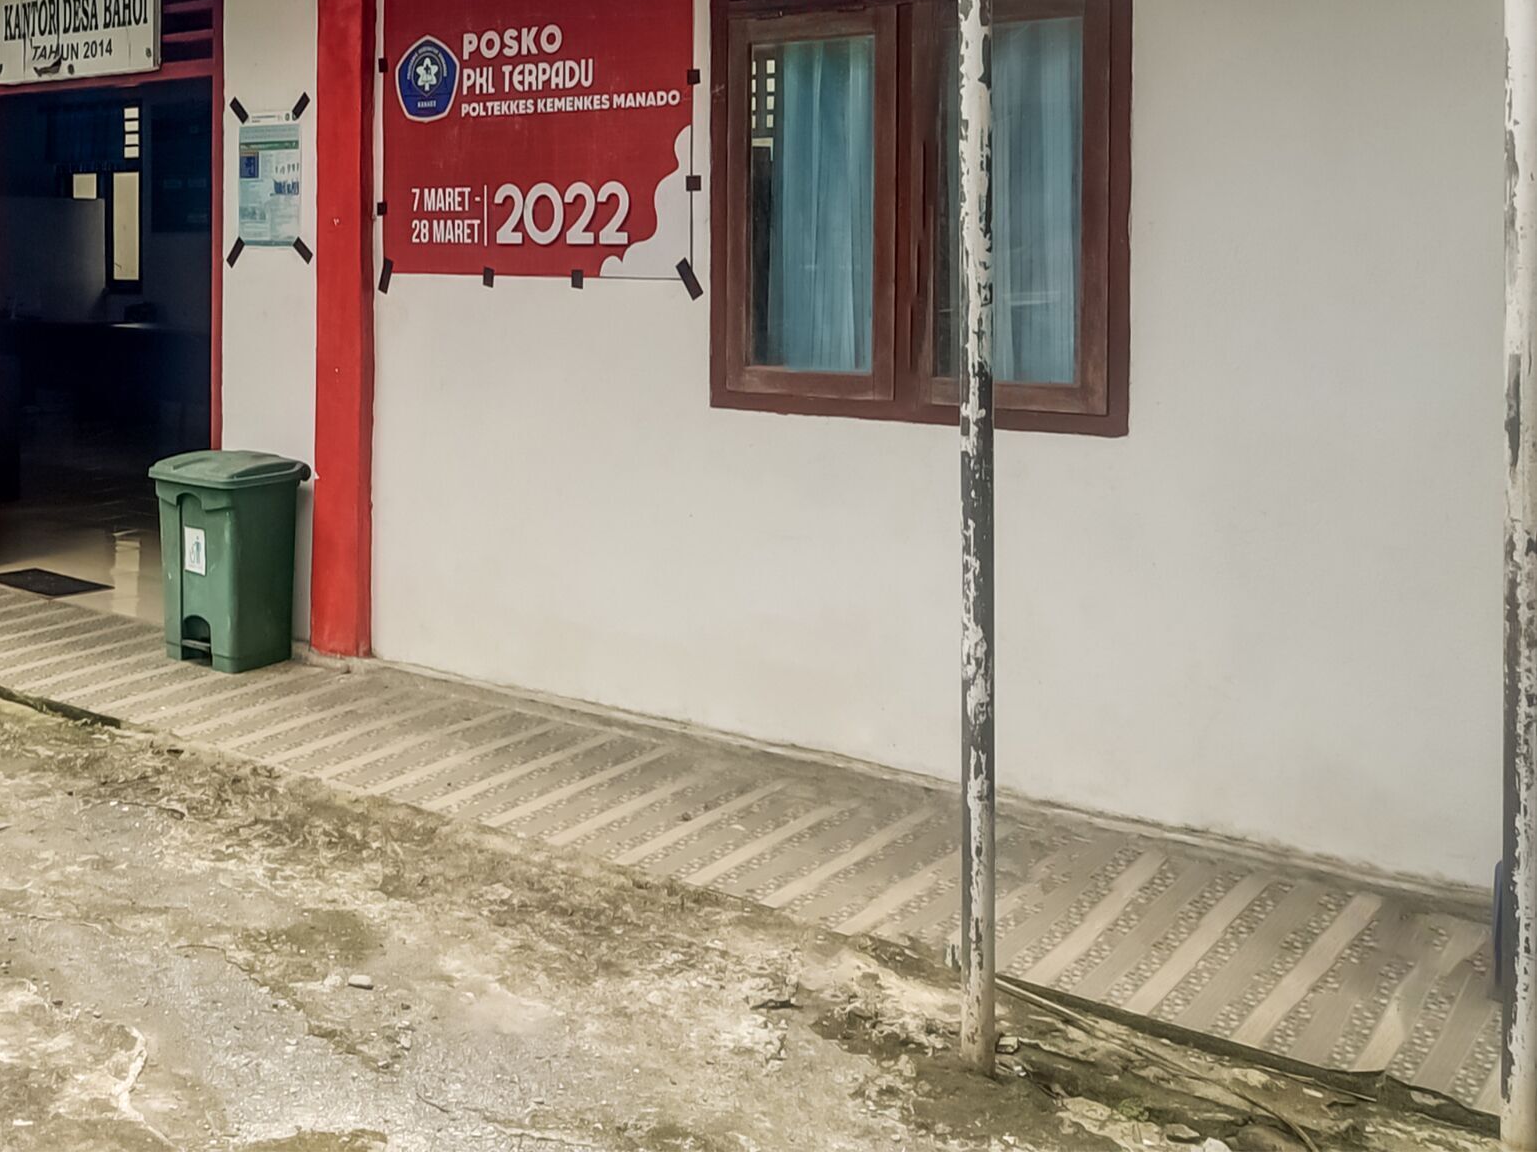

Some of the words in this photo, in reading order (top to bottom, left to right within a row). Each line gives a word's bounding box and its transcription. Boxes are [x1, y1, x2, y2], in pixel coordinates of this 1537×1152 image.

[31, 43, 79, 61] TAHUN
[83, 39, 113, 59] 2014
[463, 24, 562, 60] POSKO
[502, 58, 593, 93] TERPADU
[462, 99, 534, 117] POLTEKKES
[537, 94, 610, 113] KEMENKES
[613, 89, 680, 109] MANADO
[411, 188, 420, 212] 7
[423, 187, 471, 212] MARET
[494, 181, 629, 245] 2022
[411, 220, 429, 243] 28
[433, 219, 481, 244] MARET
